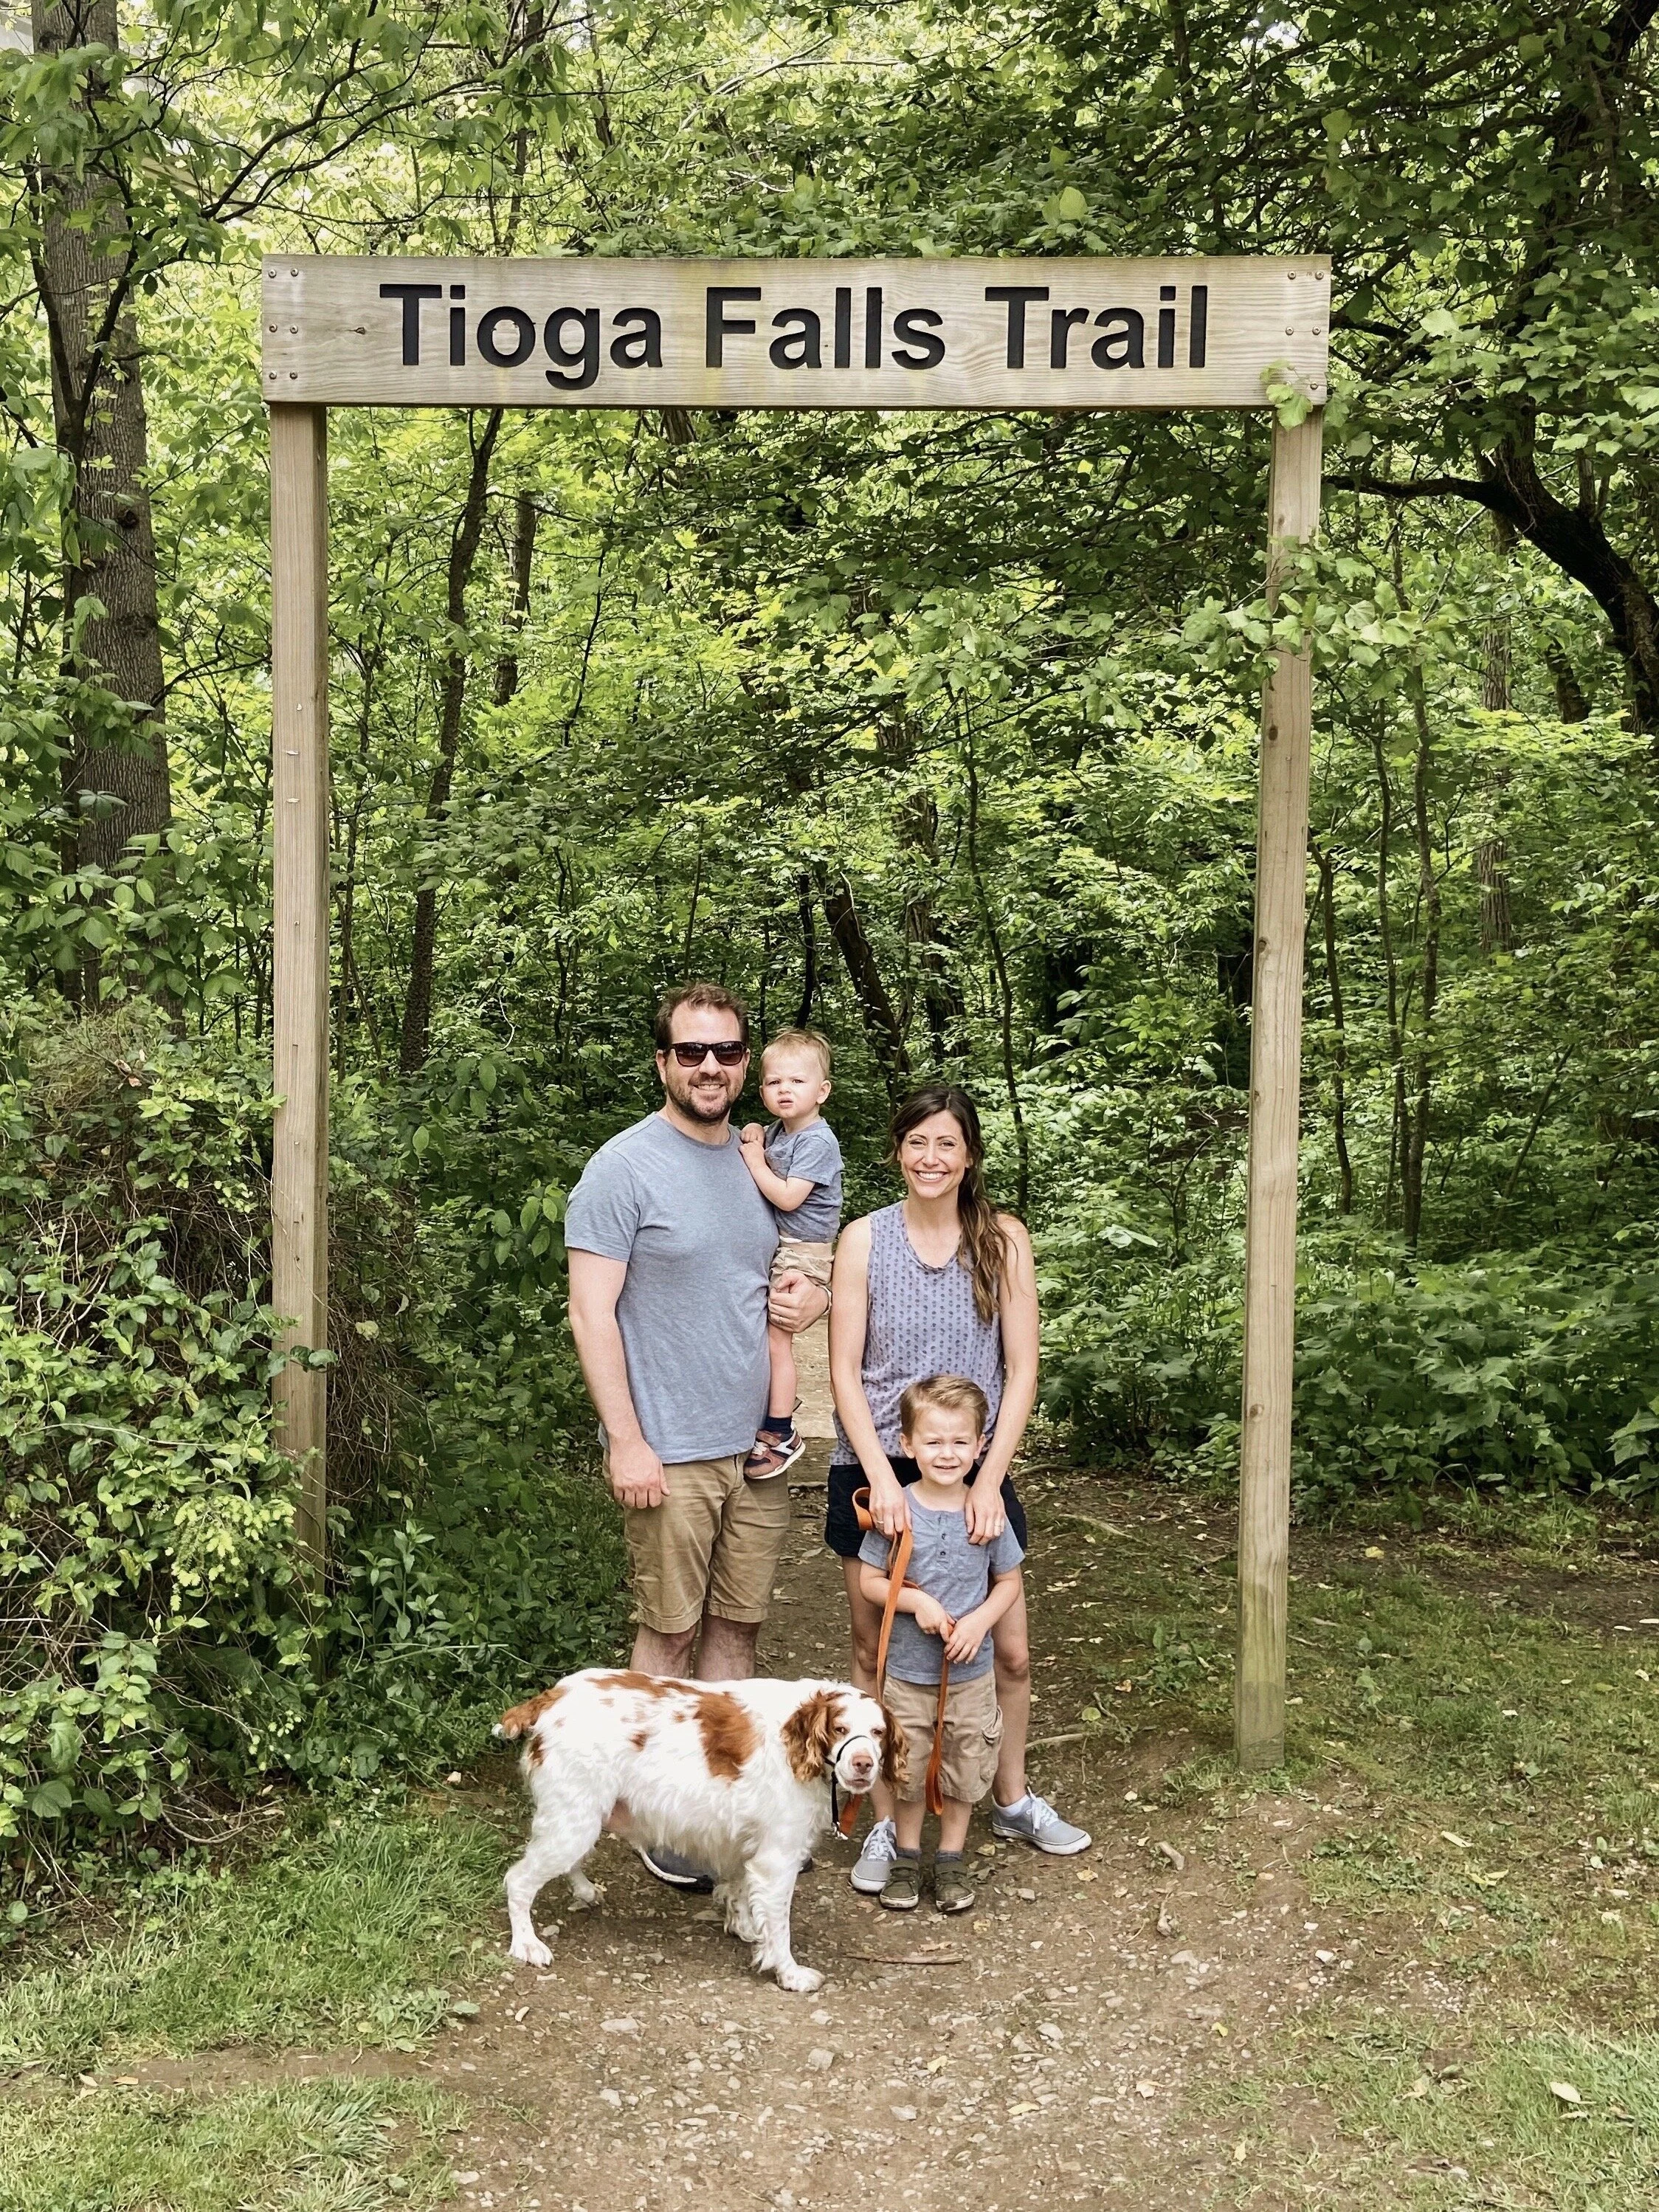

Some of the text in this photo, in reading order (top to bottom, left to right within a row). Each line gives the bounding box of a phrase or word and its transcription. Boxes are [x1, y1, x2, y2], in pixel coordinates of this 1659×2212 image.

[380, 283, 1208, 390] Tioga Falls Trail
